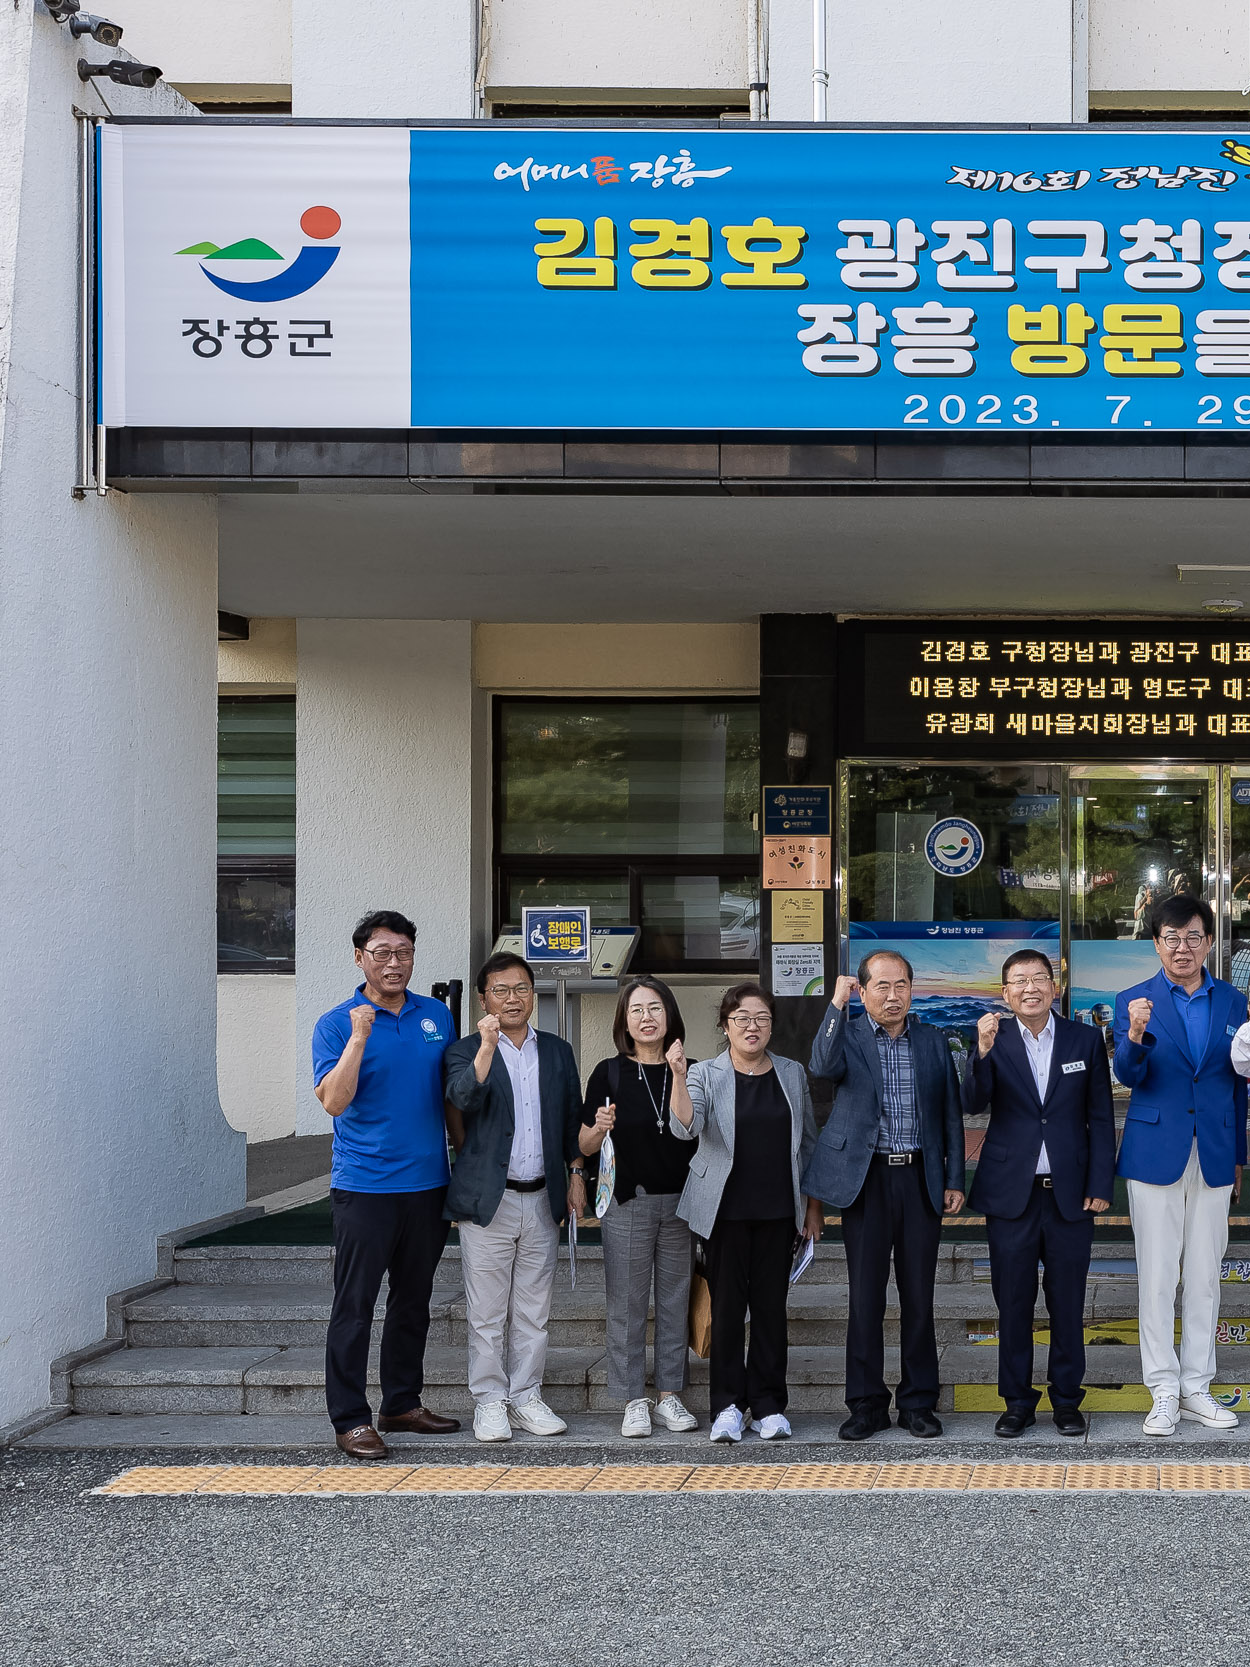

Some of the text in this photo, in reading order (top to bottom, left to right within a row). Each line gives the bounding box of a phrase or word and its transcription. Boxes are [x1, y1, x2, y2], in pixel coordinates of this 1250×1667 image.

[1100, 163, 1237, 193] 정남진
[533, 216, 808, 290] 김경호
[182, 317, 334, 360] 장흥군
[797, 301, 979, 376] 장흥
[903, 394, 1060, 427] 2023.
[1105, 395, 1152, 427] 7.
[920, 641, 991, 663] 김경호
[1001, 641, 1121, 665] 구청장님과
[1129, 641, 1200, 663] 광진구
[909, 677, 981, 699] 이용창
[988, 677, 1133, 701] 부구청장님과
[1142, 677, 1212, 699] 영도구
[925, 713, 995, 735] 유광희
[1005, 713, 1198, 737] 새마을지회장님과
[768, 844, 827, 859] 여성친화도시
[547, 921, 582, 935] 장애인
[547, 936, 583, 950] 보행로
